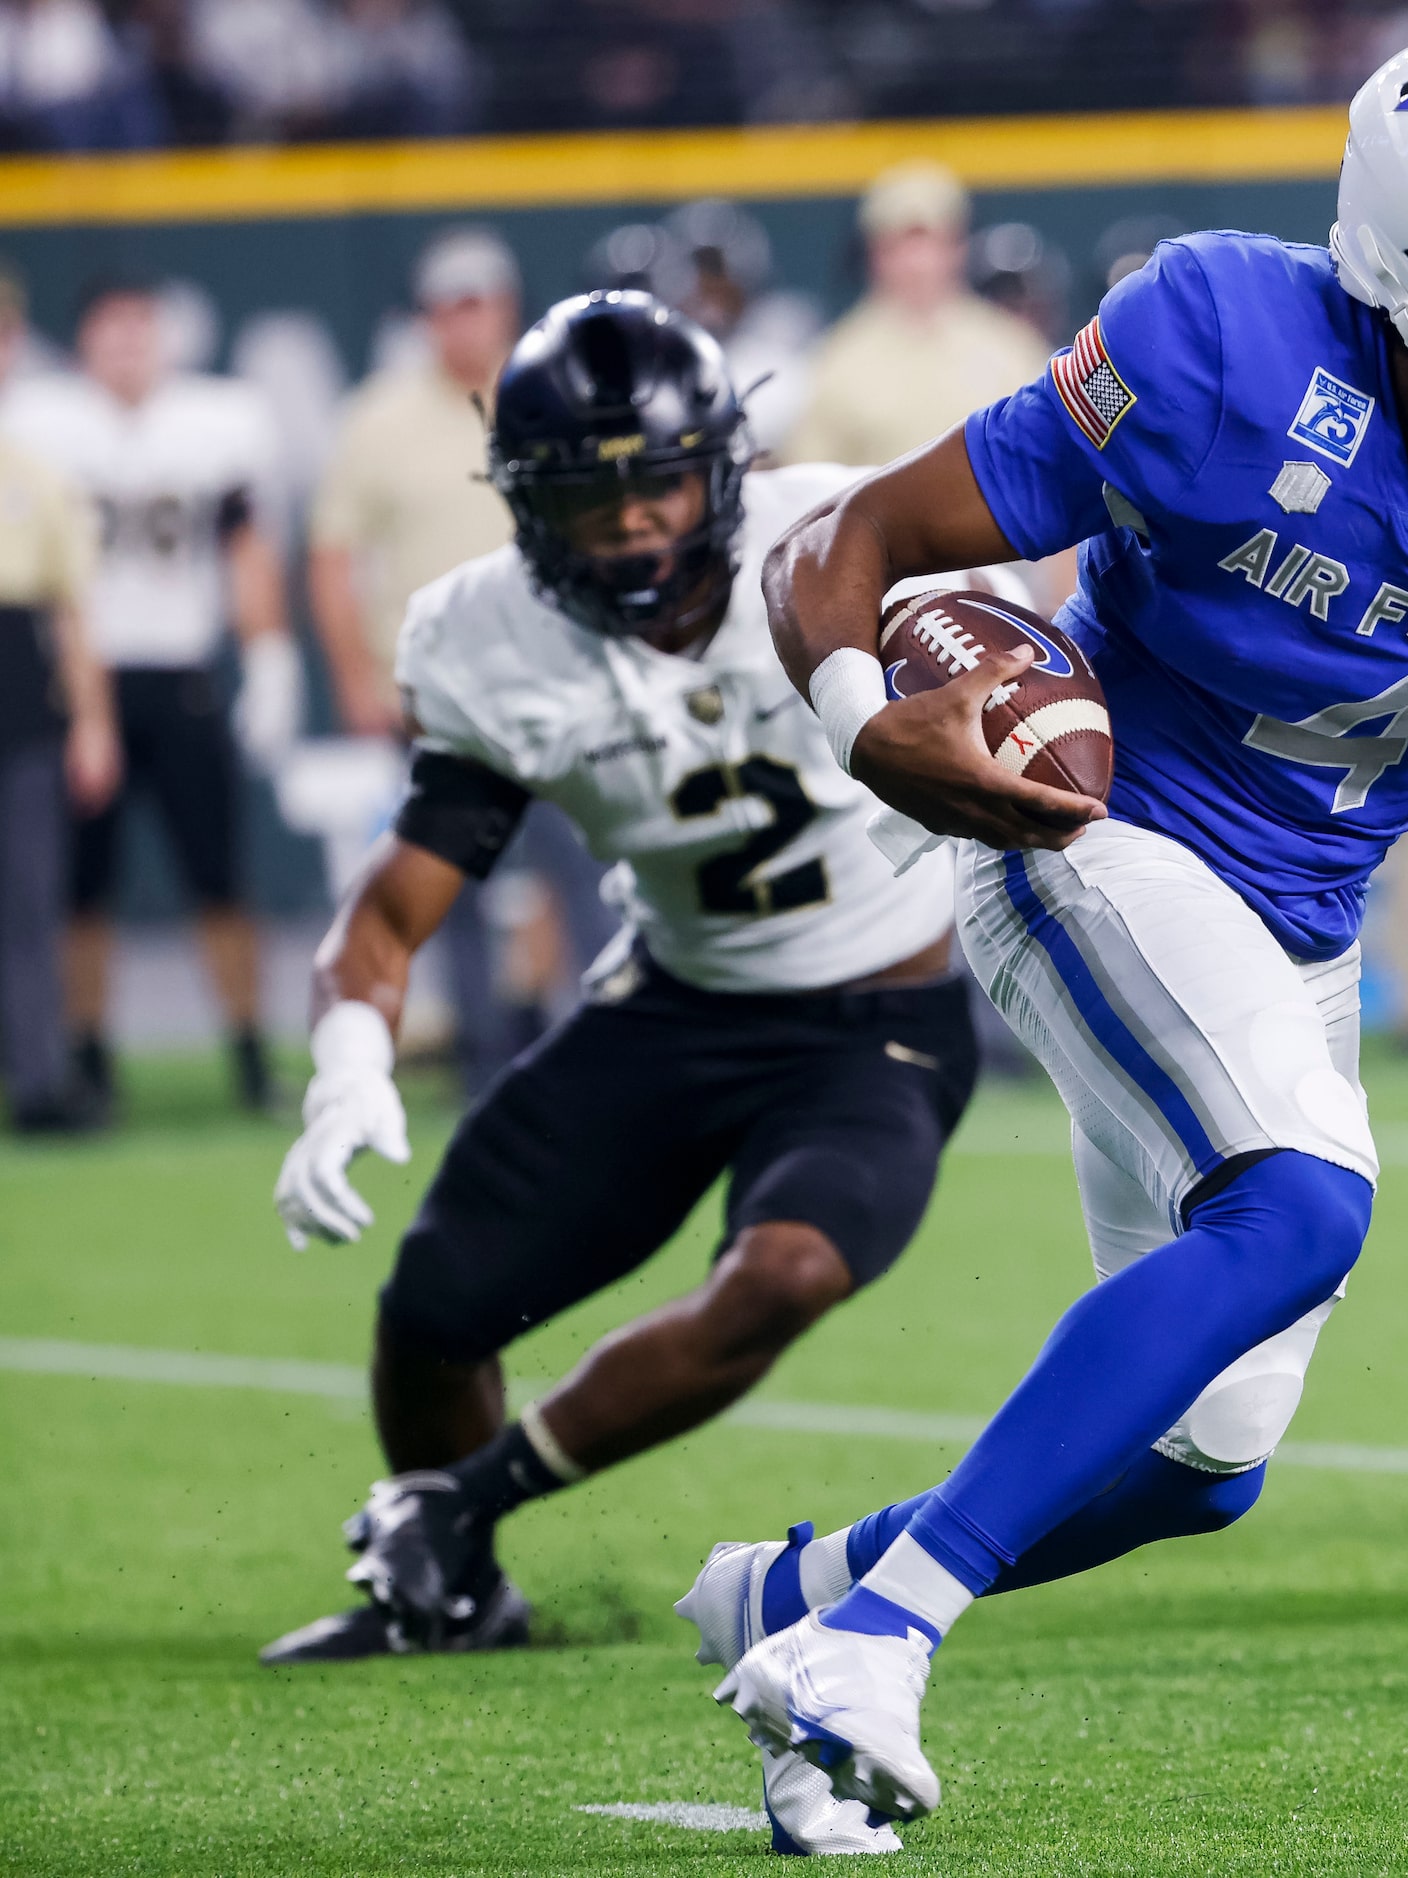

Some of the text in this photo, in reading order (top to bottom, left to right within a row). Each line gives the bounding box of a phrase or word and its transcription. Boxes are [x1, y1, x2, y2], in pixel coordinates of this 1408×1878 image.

[1307, 387, 1361, 445] 75
[1217, 528, 1351, 622] AIR
[671, 753, 833, 917] 2
